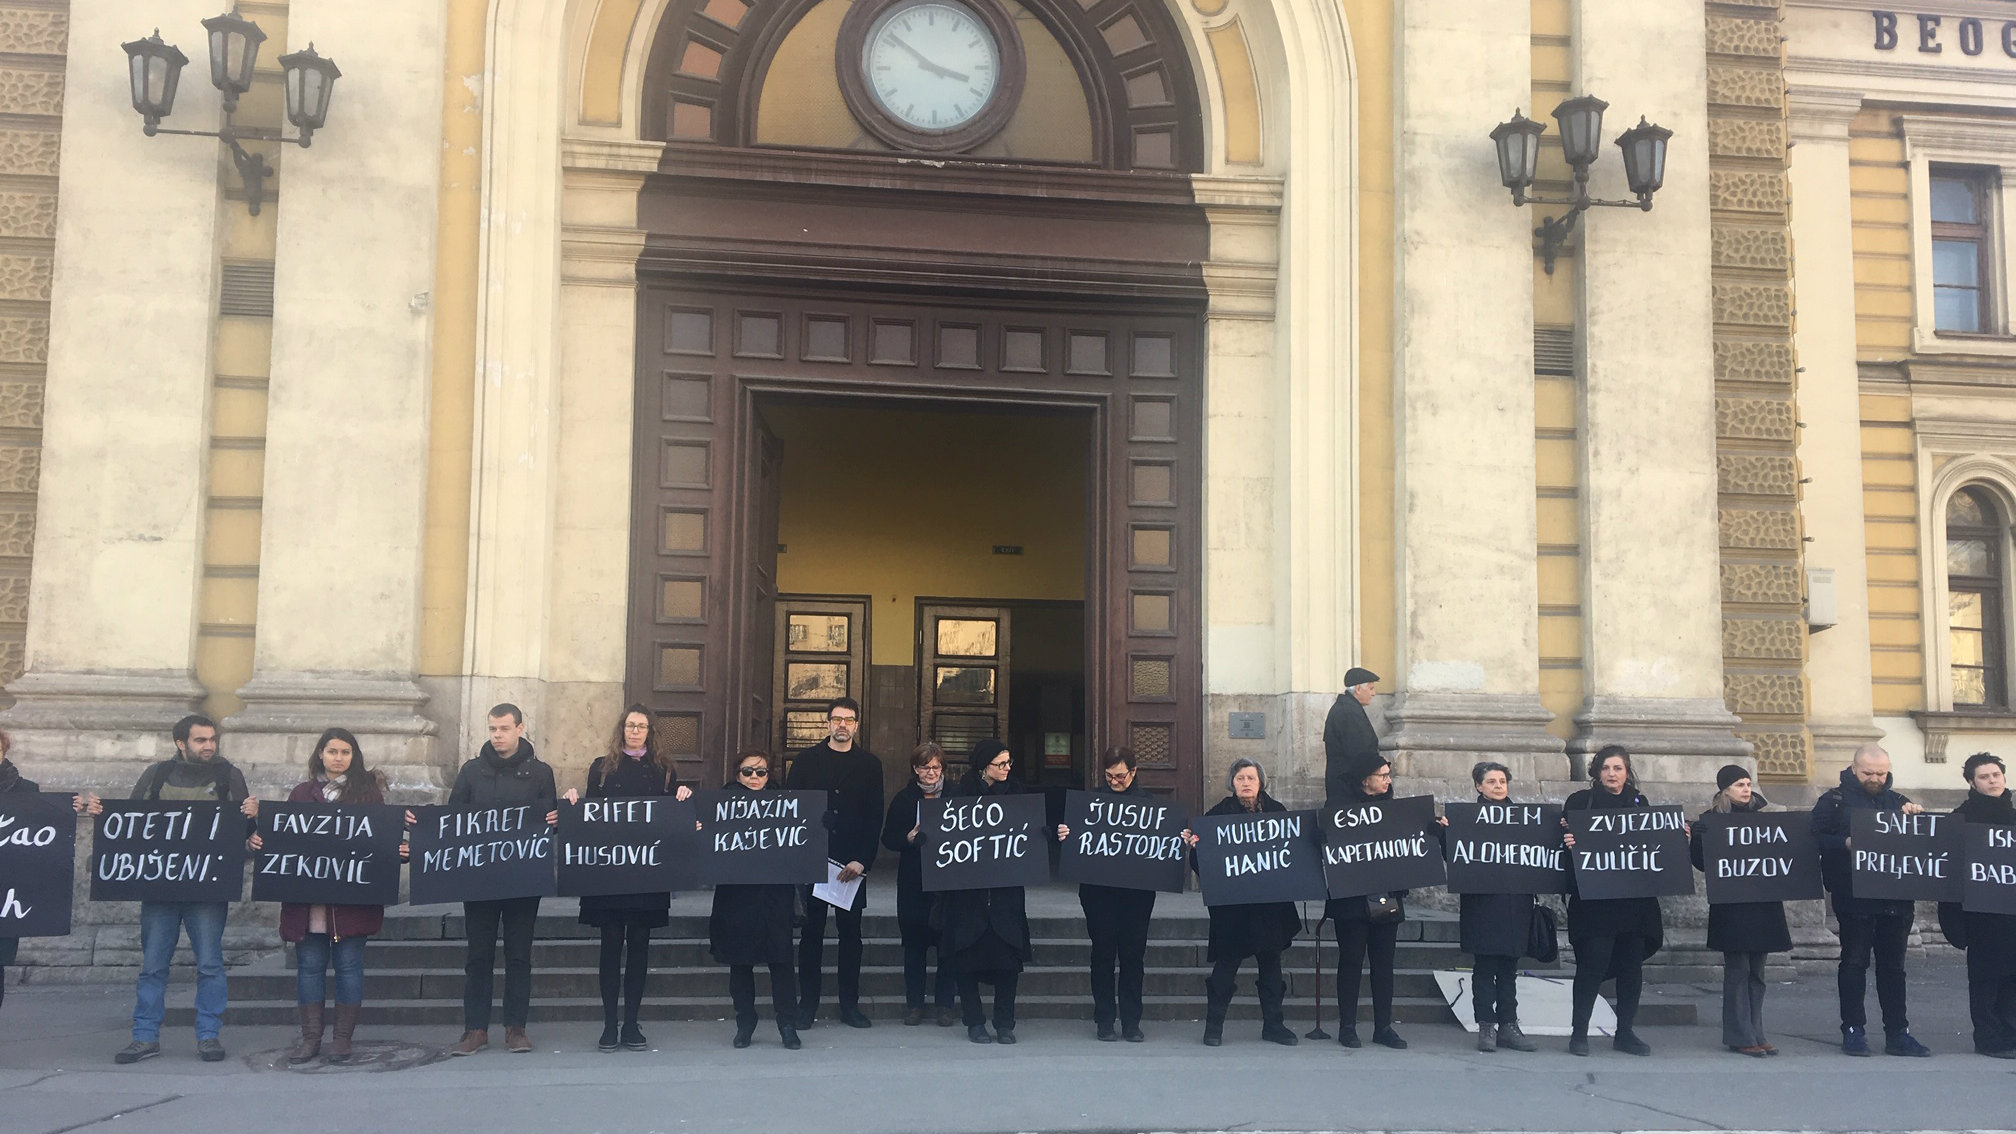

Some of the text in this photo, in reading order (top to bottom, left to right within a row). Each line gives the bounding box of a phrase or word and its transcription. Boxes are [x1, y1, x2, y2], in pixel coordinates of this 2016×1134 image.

[439, 805, 530, 839] FIKRET
[584, 798, 657, 823] RIFET
[716, 795, 797, 821] NIJAZIM
[941, 798, 1003, 832] ŠEĆO
[1085, 798, 1167, 830] JUSUF
[1334, 807, 1382, 829] ESAD
[1476, 806, 1541, 825] ADEM
[1589, 811, 1685, 835] ZVJEZDAN
[102, 807, 192, 840] OTETI
[274, 809, 372, 840] FAVZIJA
[715, 817, 807, 852] KAJEVIĆ
[1217, 816, 1300, 845] MUHEDIN
[1726, 826, 1788, 846] TOMA
[424, 827, 549, 873] MEMETOVIĆ
[566, 840, 660, 865] HUSOVIĆ
[936, 822, 1028, 867] SOFTIĆ
[1079, 831, 1183, 861] RASTODER
[1225, 841, 1291, 877] HANIĆ
[1326, 831, 1428, 864] KAPETANOVIĆ
[1580, 844, 1663, 871] ZULIČIĆ
[261, 852, 372, 884] ZEKOVIĆ
[1719, 858, 1793, 877] BUZOV
